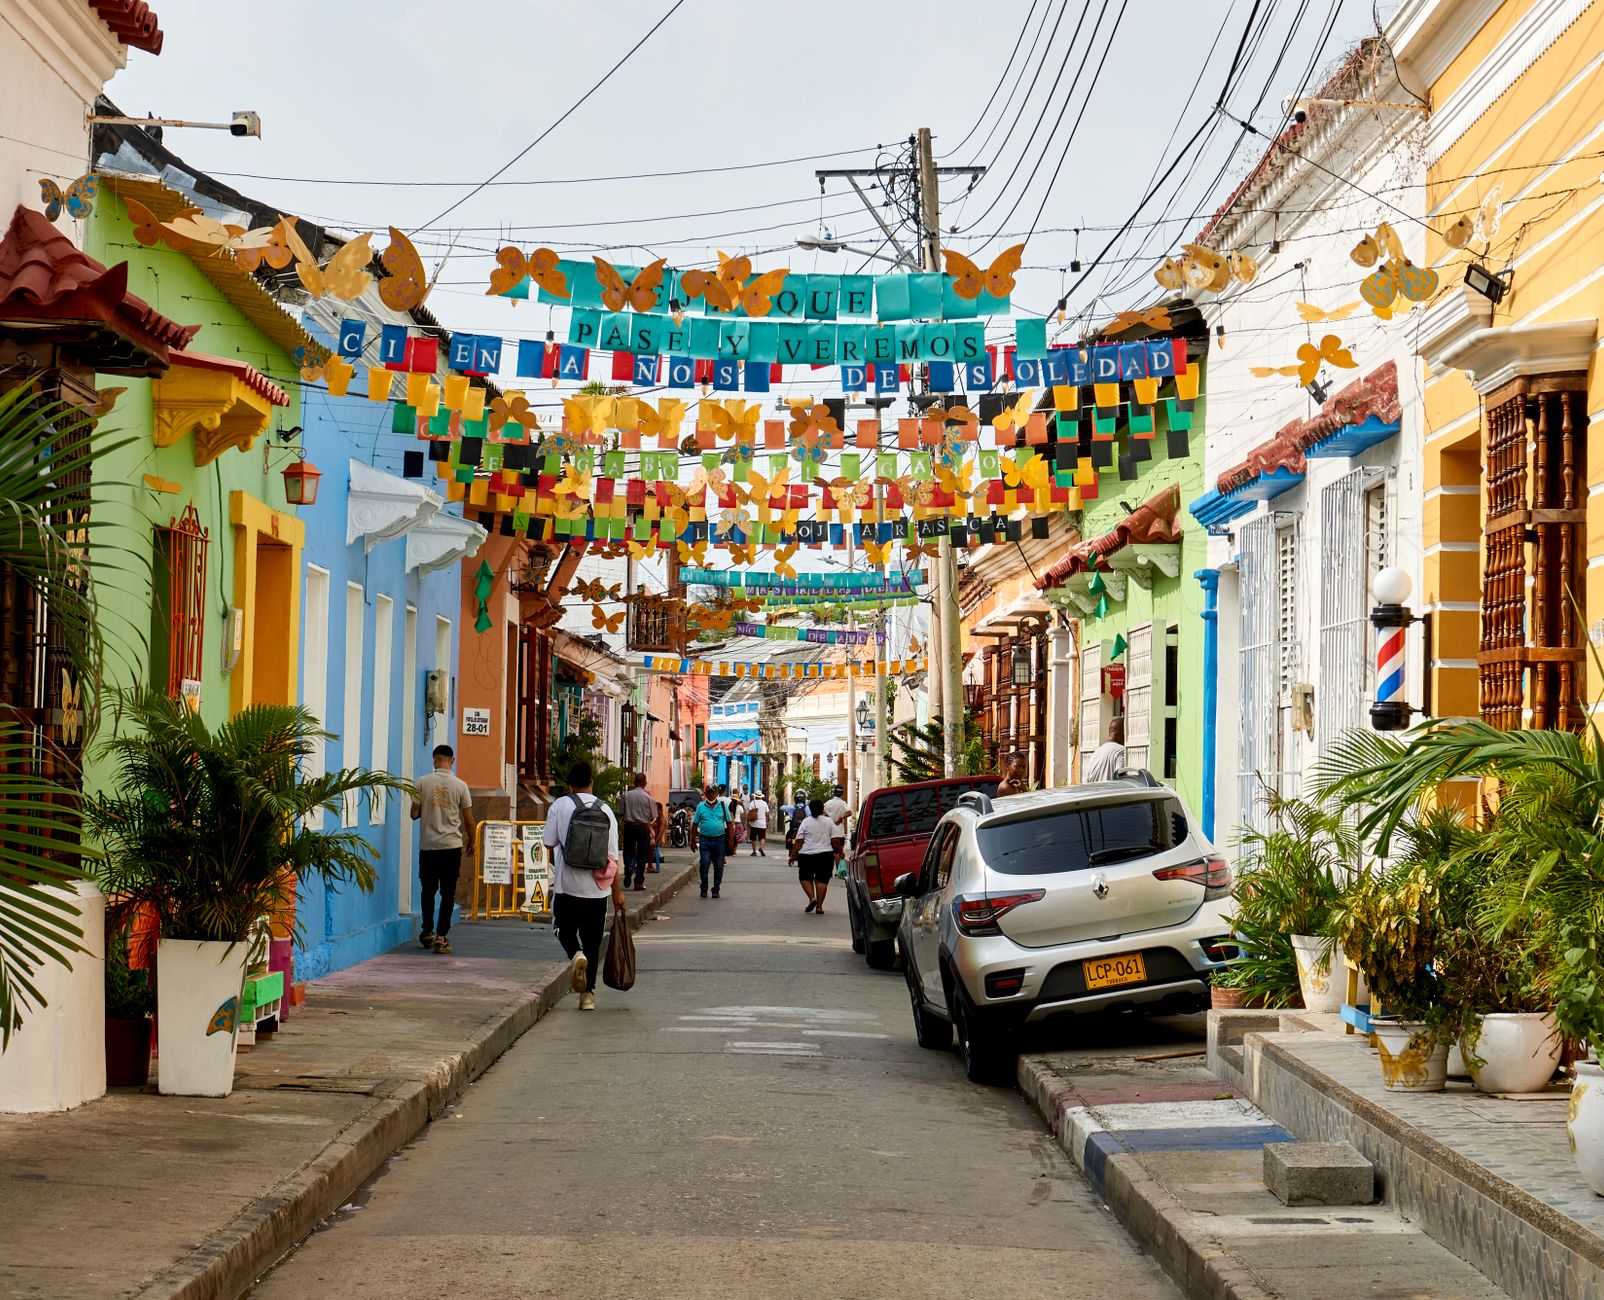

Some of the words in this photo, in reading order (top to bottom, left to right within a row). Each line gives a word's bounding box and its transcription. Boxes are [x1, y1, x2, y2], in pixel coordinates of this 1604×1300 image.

[777, 290, 866, 316] QUE
[577, 325, 683, 350] PASE
[726, 335, 745, 356] Y
[783, 336, 978, 361] VEREMOS
[343, 333, 498, 368] CIEN
[846, 369, 896, 389] DE
[972, 351, 1171, 385] SOLEDAD
[577, 457, 676, 478] GABO
[881, 456, 996, 477] GAO
[838, 634, 884, 645] AMOR
[466, 723, 488, 733] 28-01
